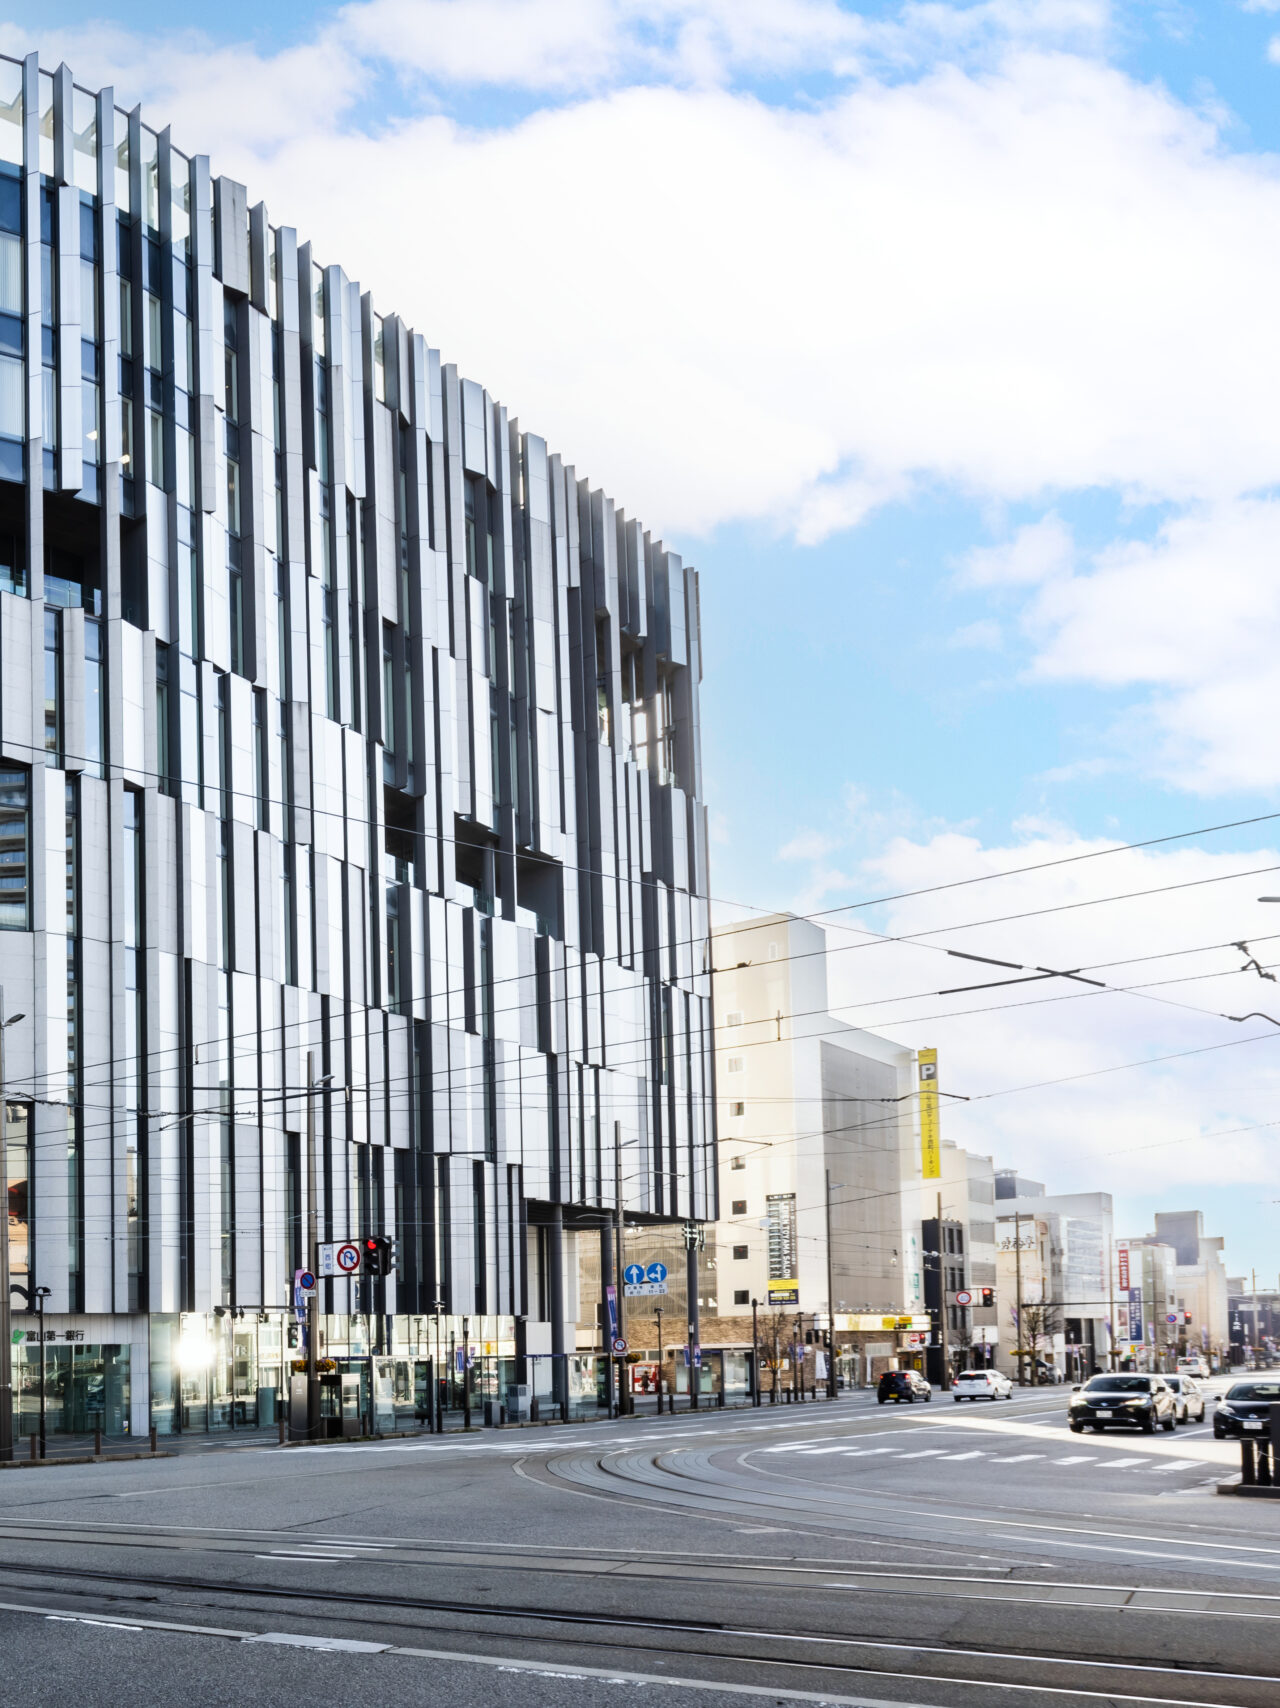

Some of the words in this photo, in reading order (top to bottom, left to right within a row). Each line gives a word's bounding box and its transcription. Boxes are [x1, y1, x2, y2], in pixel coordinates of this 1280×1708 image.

[921, 1064, 935, 1080] P
[782, 1225, 791, 1254] TOYAMA
[782, 1256, 792, 1279] SALON
[26, 1329, 85, 1342] 富山第一銀行
